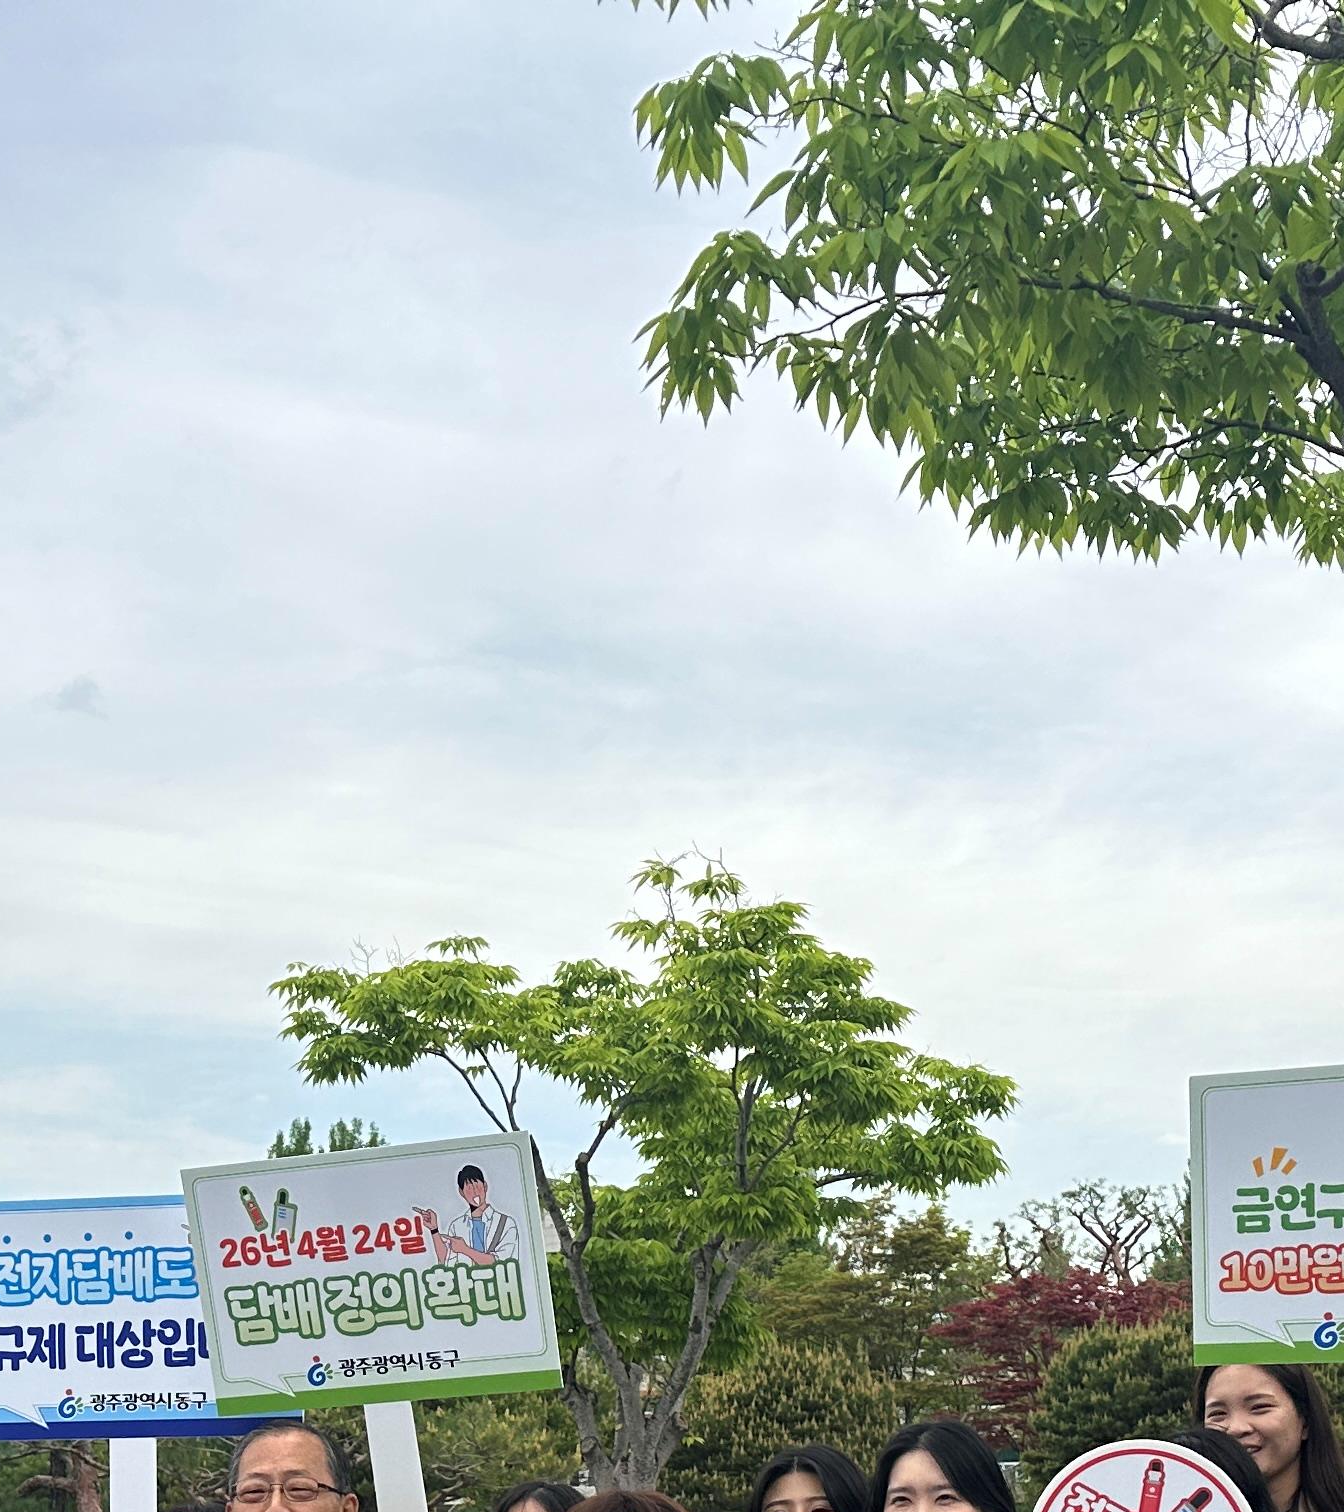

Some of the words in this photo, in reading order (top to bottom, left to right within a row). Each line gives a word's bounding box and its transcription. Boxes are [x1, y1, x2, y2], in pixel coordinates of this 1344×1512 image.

[219, 1229, 291, 1269] 26년
[297, 1226, 347, 1261] 4월
[355, 1214, 427, 1256] 24일
[224, 1276, 326, 1346] 담배
[324, 1268, 423, 1334] 정의
[424, 1258, 527, 1326] 확대
